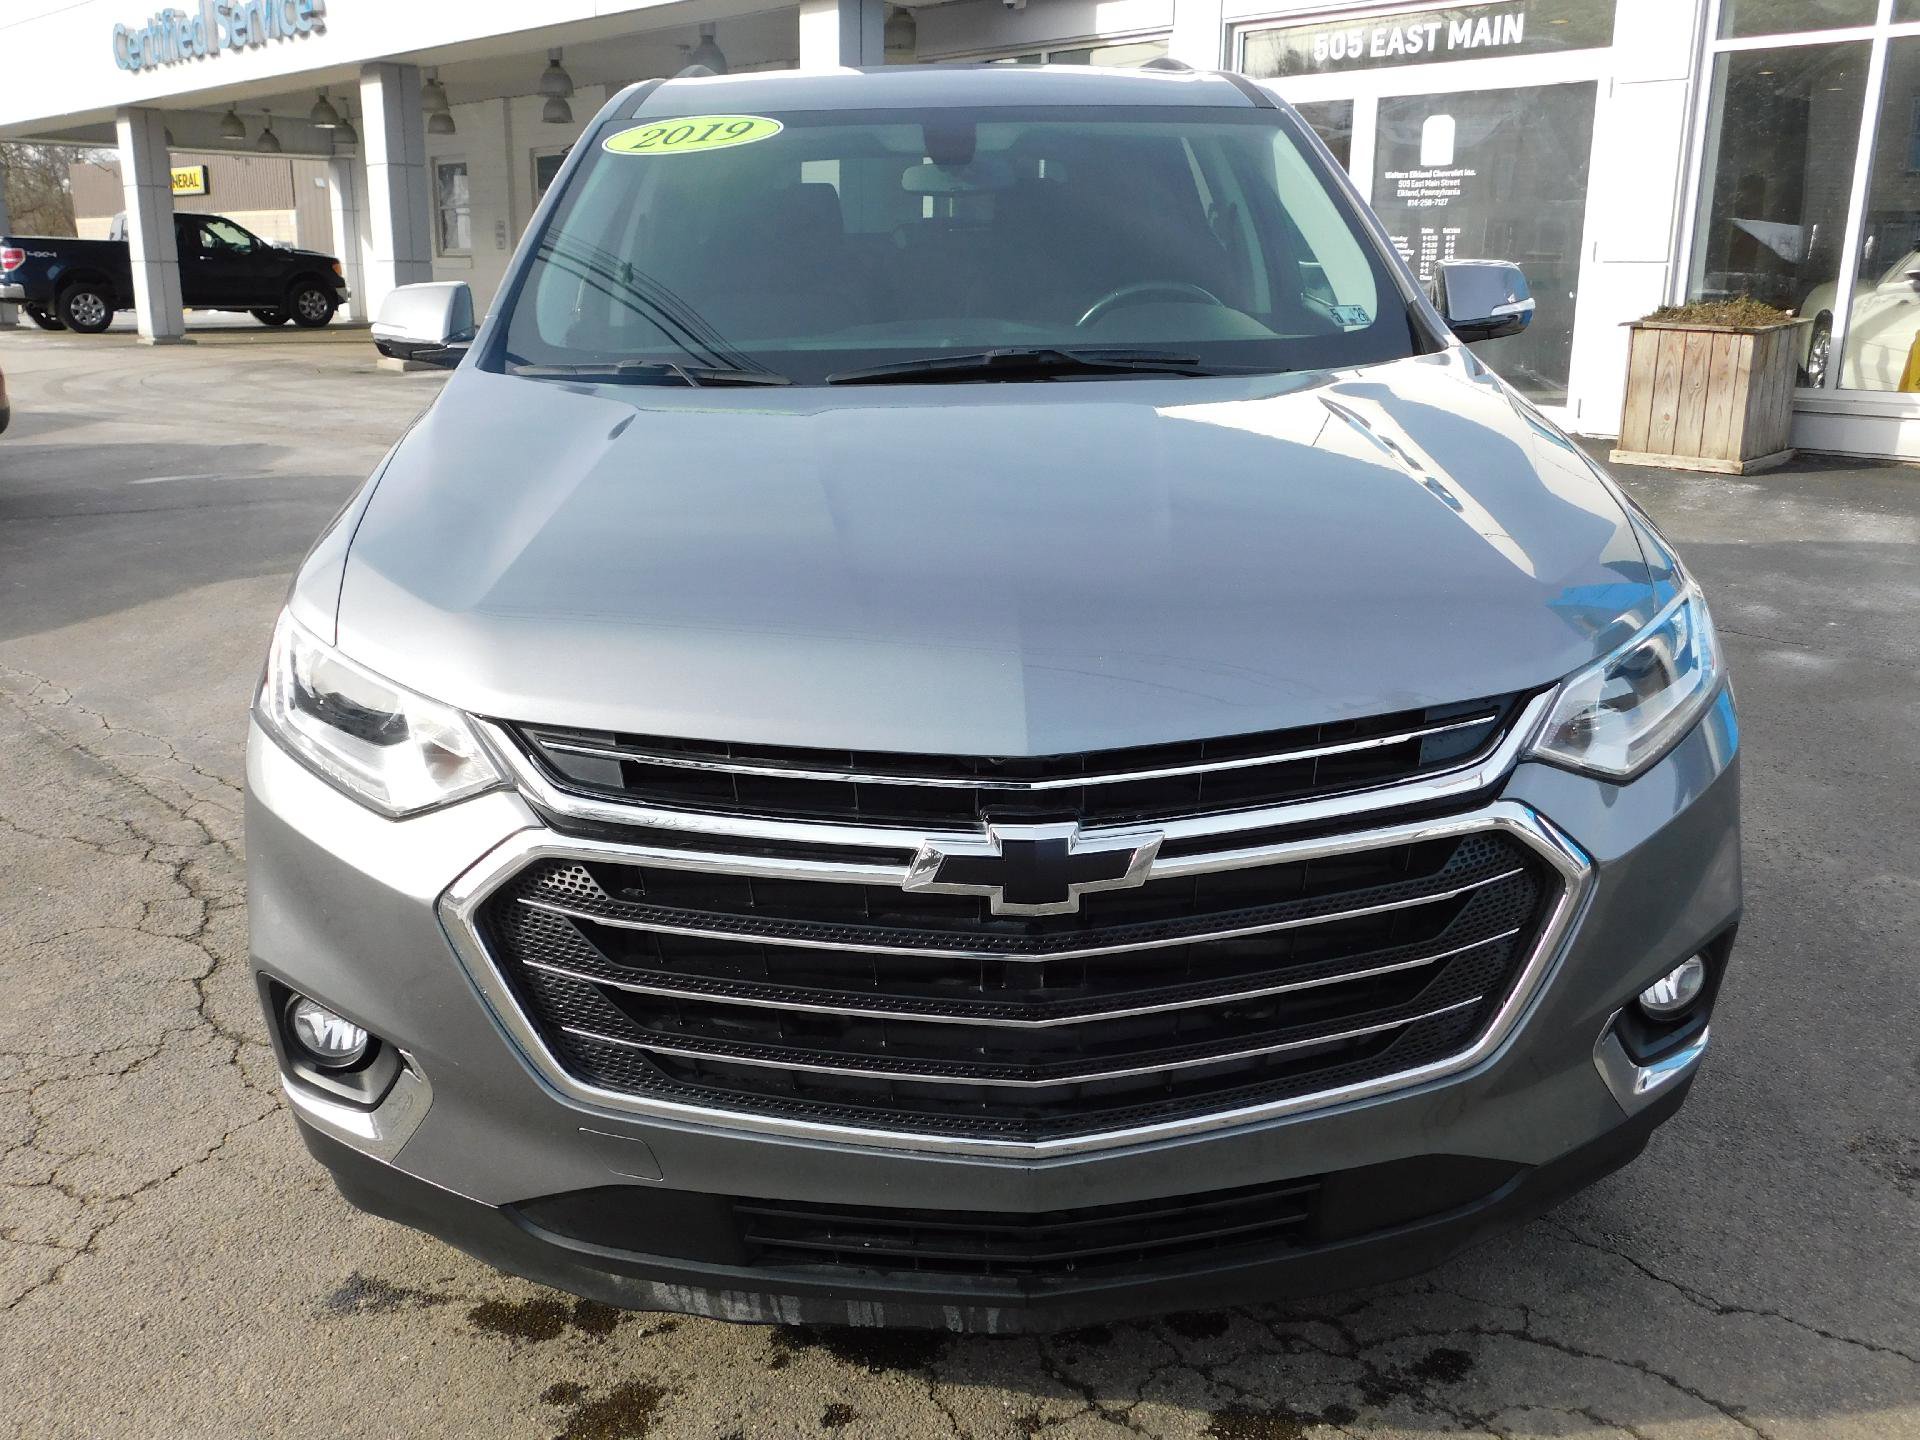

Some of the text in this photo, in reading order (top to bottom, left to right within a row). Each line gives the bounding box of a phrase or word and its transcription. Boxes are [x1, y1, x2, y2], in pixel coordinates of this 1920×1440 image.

[113, 0, 327, 74] Certified Service
[1313, 13, 1524, 61] 505 EAST MAIN
[630, 121, 755, 149] 2019
[1398, 179, 1461, 188] 505 East Main Street
